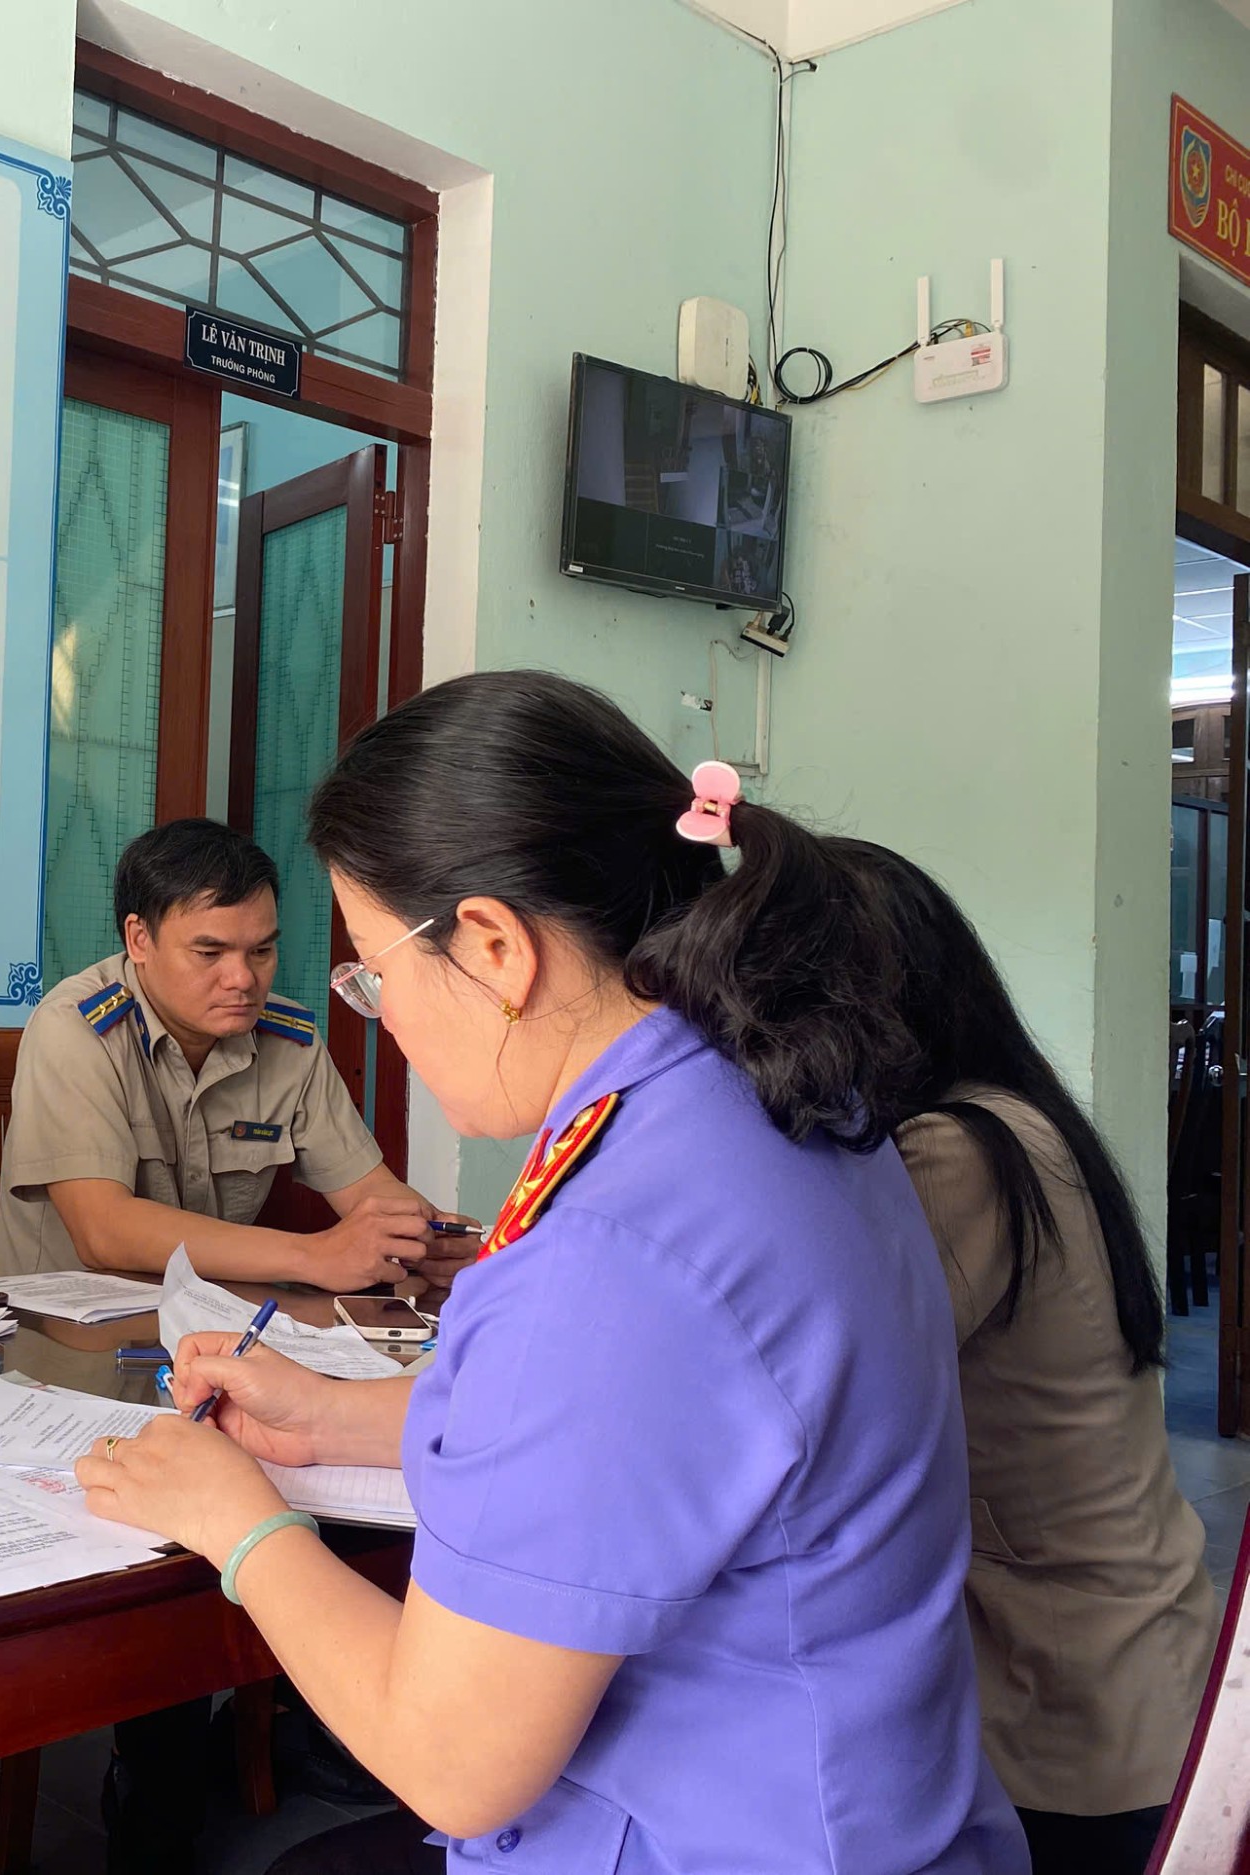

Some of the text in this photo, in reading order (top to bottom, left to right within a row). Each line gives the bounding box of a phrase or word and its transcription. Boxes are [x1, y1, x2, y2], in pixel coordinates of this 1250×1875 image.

[1217, 198, 1240, 257] BỘ
[201, 323, 286, 367] LÊ VĂN TRỊNH
[211, 355, 276, 384] TRƯỞNG PHÒNG
